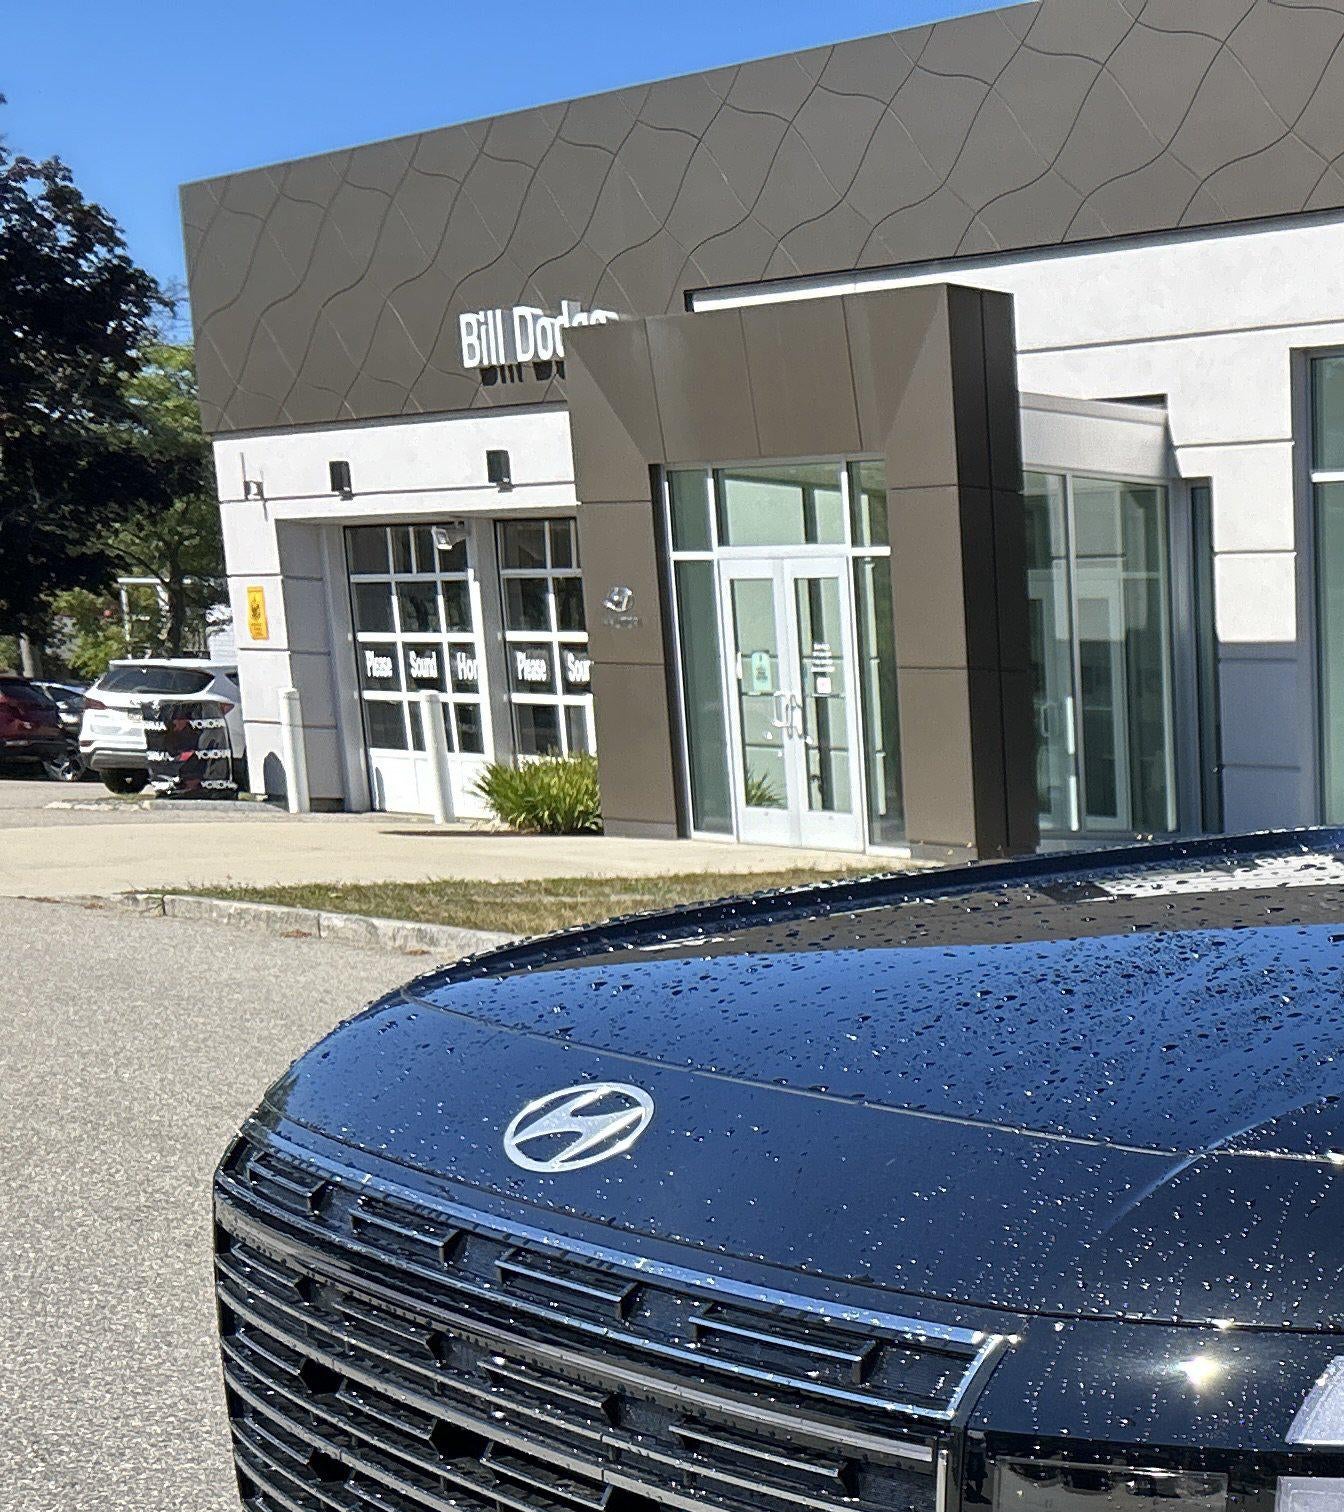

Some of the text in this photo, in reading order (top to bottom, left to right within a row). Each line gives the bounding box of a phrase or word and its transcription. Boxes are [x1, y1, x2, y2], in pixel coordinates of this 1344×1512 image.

[459, 299, 620, 369] Bill Dod
[364, 650, 479, 680] Please Sound Hor
[516, 651, 548, 682] Please
